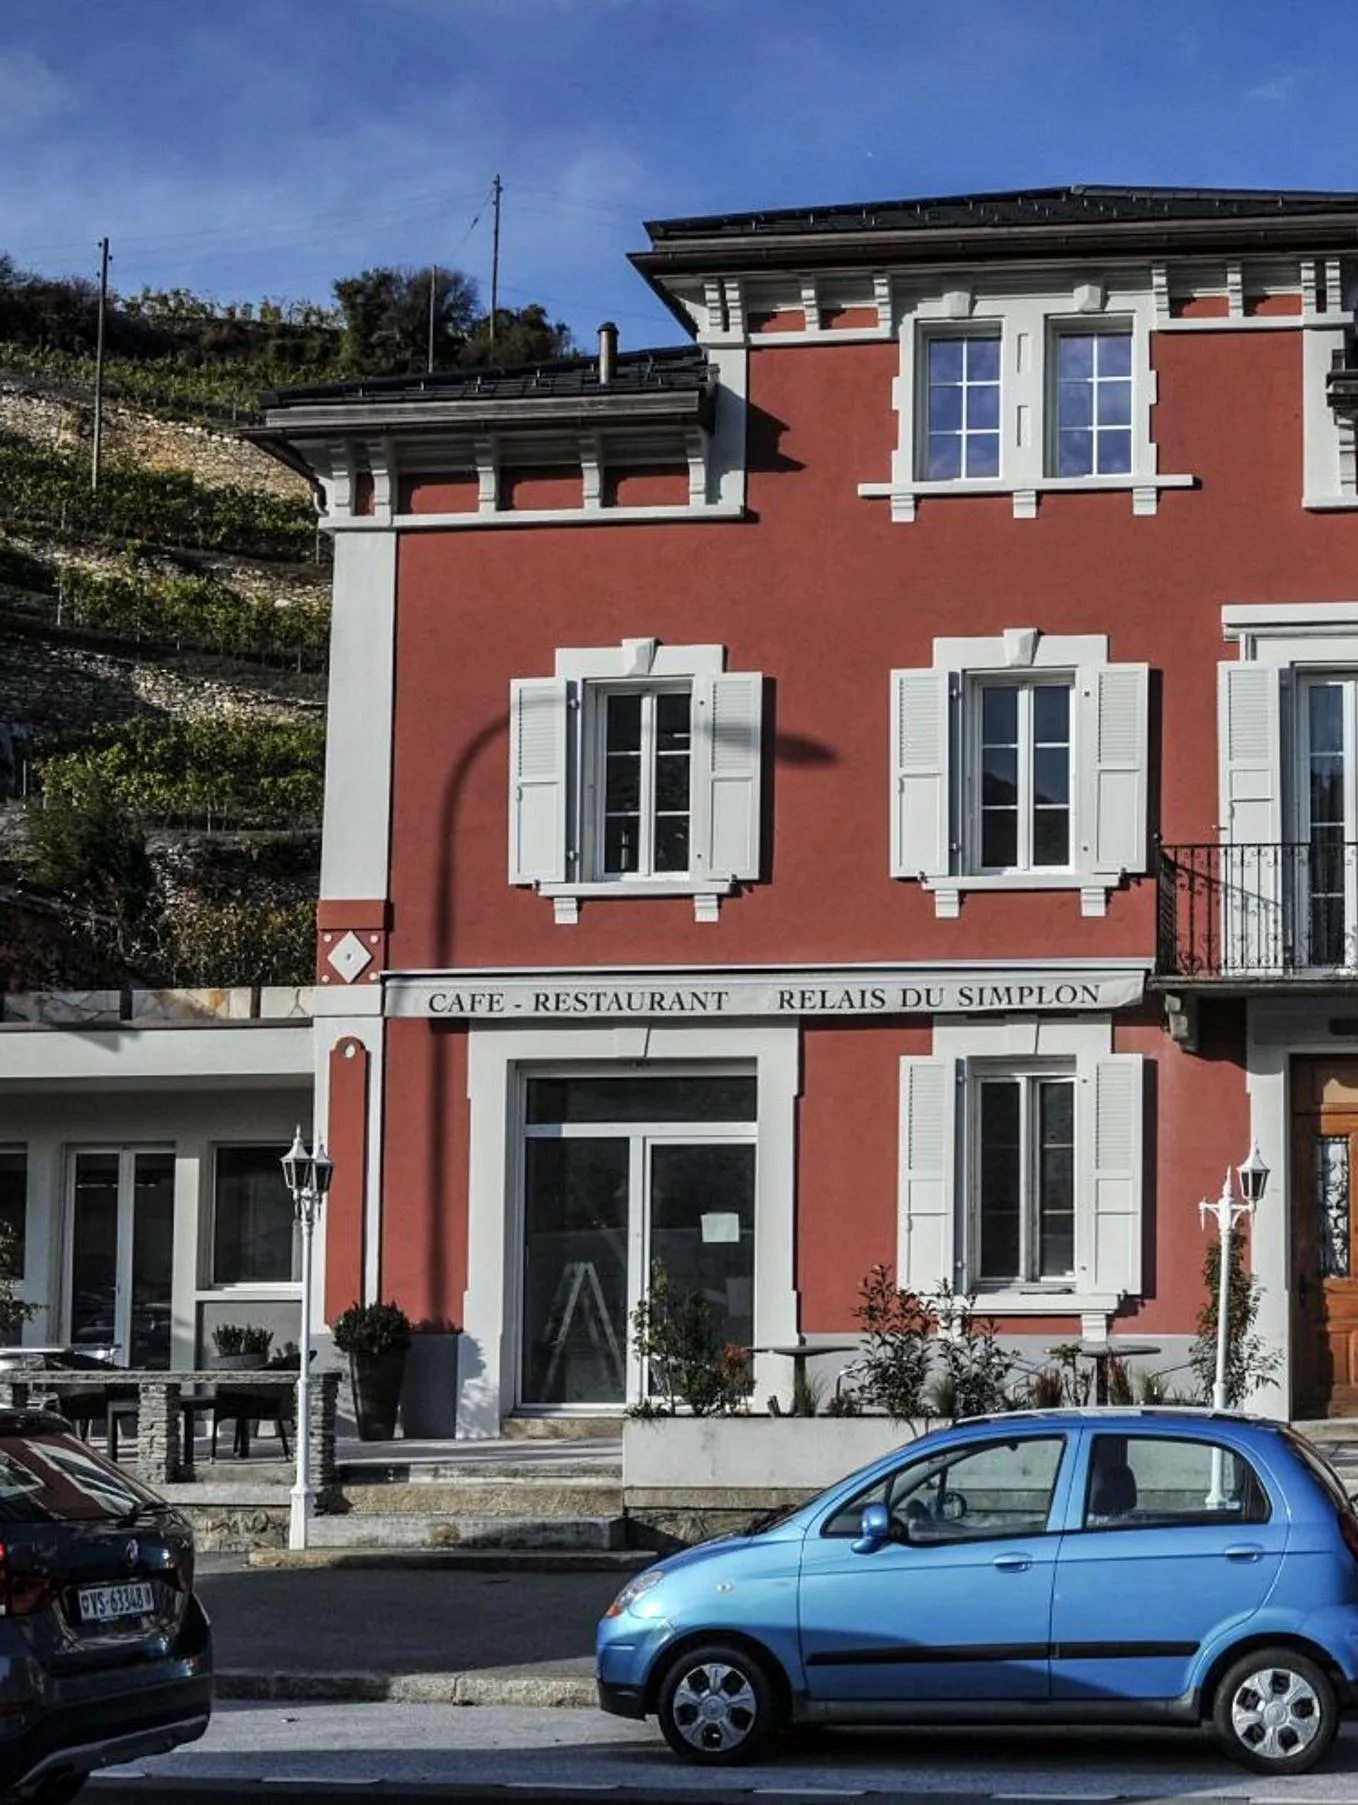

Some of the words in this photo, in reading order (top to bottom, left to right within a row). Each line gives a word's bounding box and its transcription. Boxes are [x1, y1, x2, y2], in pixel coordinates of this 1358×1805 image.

[428, 993, 505, 1013] CAFE
[533, 991, 728, 1013] RESTAURANT
[778, 988, 886, 1010] RELAIS
[900, 987, 943, 1008] DU
[958, 984, 1101, 1007] SIMPLON
